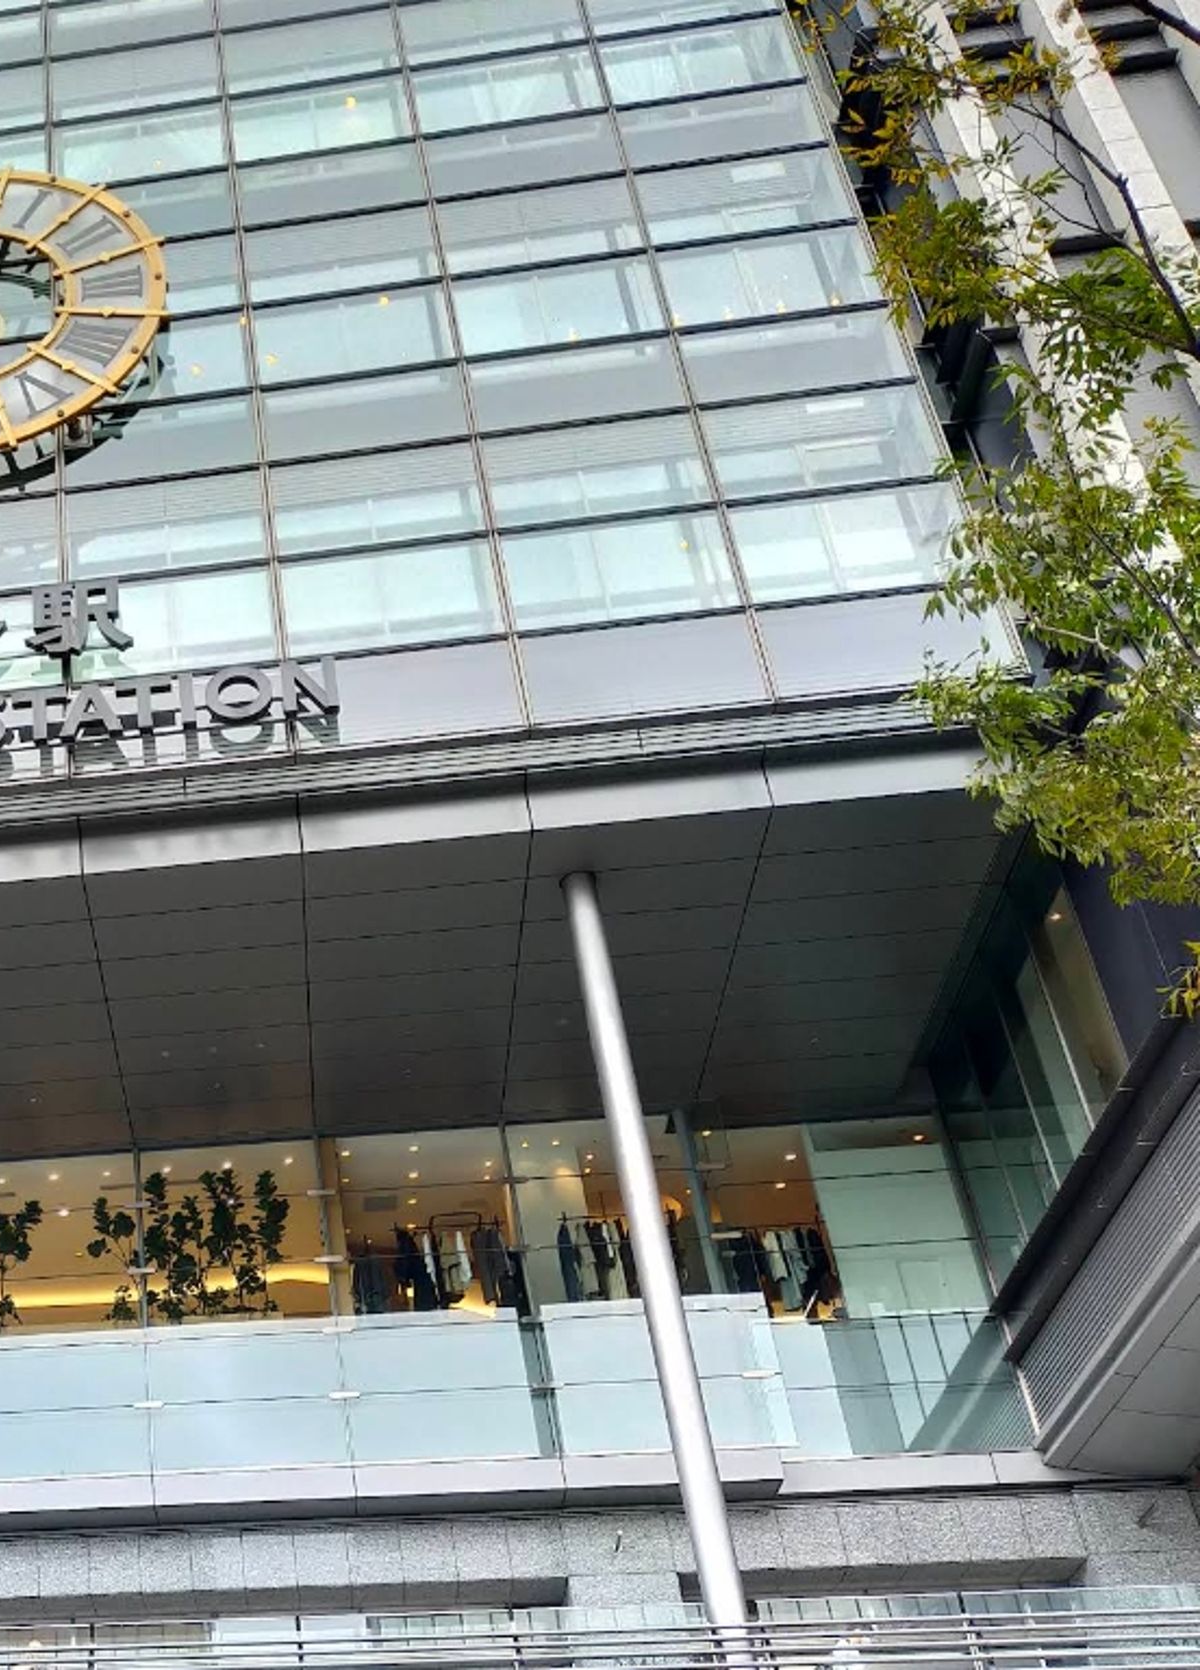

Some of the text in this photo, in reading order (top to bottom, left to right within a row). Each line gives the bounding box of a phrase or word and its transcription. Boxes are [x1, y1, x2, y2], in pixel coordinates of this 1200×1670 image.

[12, 189, 52, 229] I
[57, 215, 123, 258] II
[81, 265, 142, 302] III
[14, 371, 75, 418] V
